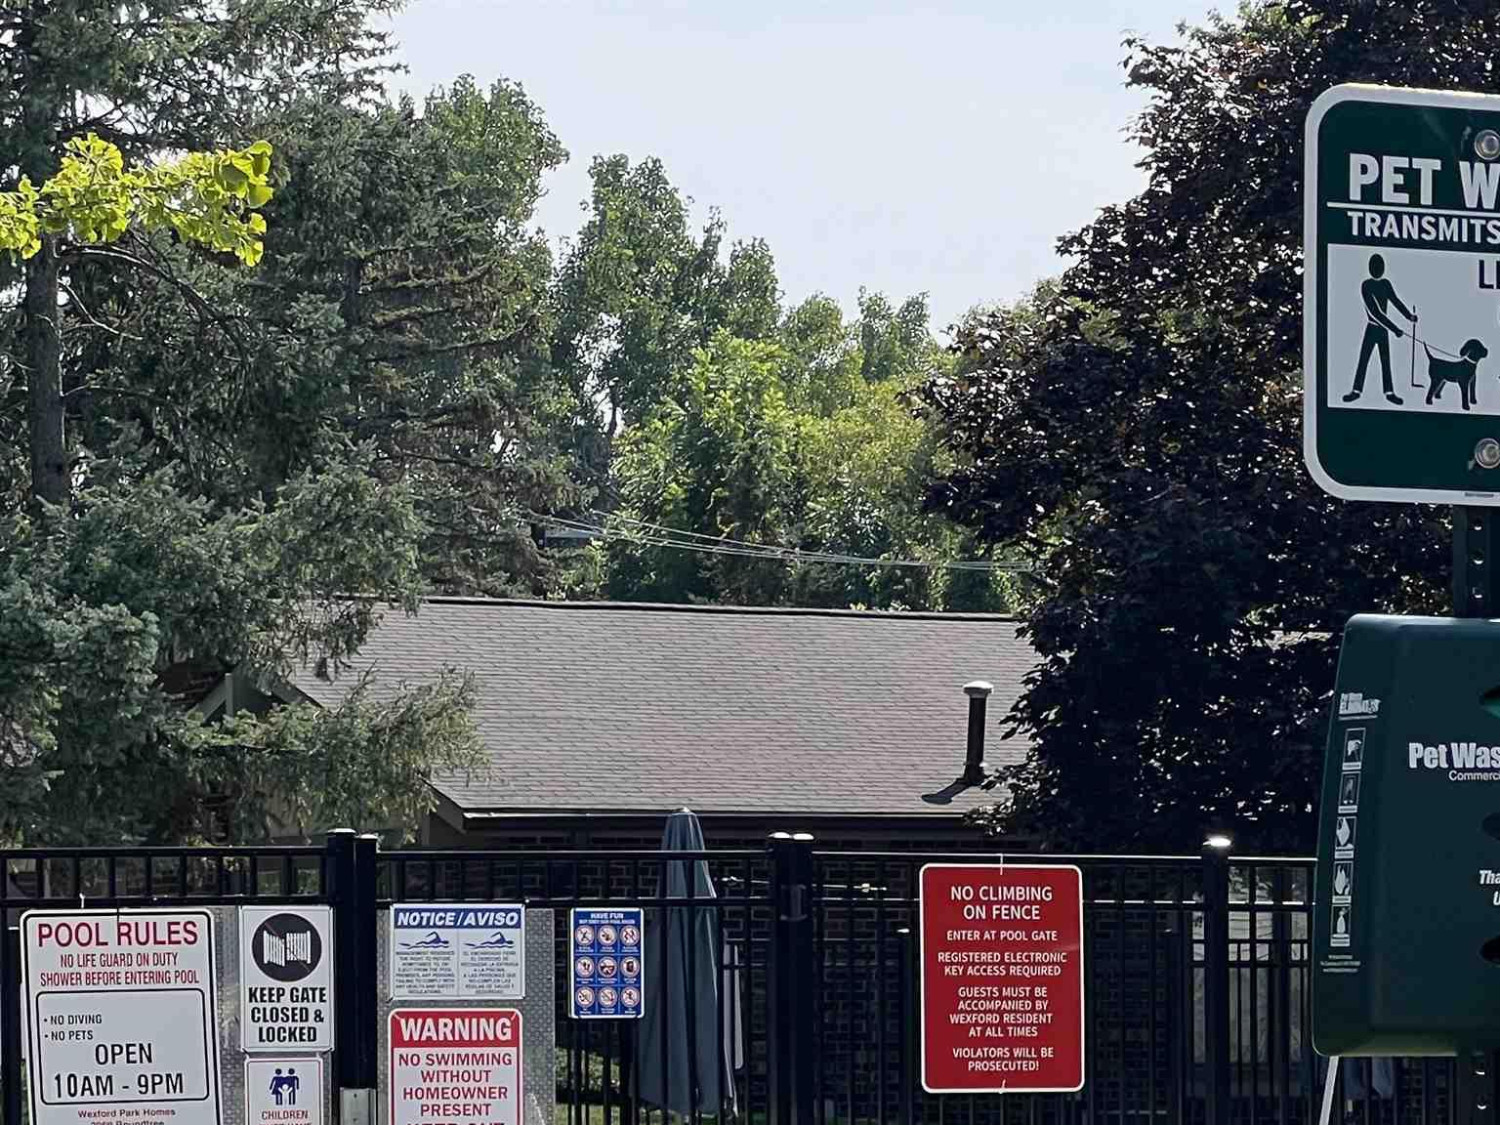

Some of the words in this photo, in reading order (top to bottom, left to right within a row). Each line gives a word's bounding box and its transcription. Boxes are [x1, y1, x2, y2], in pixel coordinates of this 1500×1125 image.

[1349, 153, 1441, 205] PET
[1408, 742, 1449, 769] Pet
[951, 886, 973, 901] NO
[979, 886, 1053, 901] CLIMBING
[963, 905, 987, 920] ON
[992, 905, 1041, 920] FENCE
[38, 922, 108, 947] POOL
[117, 921, 198, 946] RULES
[947, 931, 980, 941] ENTER
[983, 931, 996, 941] AT
[1000, 931, 1028, 941] POOL
[1031, 931, 1058, 941] GATE
[60, 954, 74, 967] NO
[77, 953, 97, 967] LIFE
[99, 953, 133, 967] GUARD
[136, 953, 150, 966] ON
[152, 952, 178, 966] DUTY
[938, 952, 1001, 963] REGISTERED
[1004, 952, 1067, 963] ELECTRONIC
[40, 972, 82, 986] SHOWER
[85, 971, 121, 985] BEFORE
[124, 970, 171, 985] ENTERING
[174, 970, 200, 984] POOL
[944, 966, 964, 976] KEY
[967, 966, 1006, 976] ACCESS
[1009, 966, 1061, 977] REQUIRED
[249, 987, 286, 1003] KEEP
[290, 987, 327, 1003] GATE
[958, 987, 999, 998] GUESTS
[1002, 987, 1031, 997] MUST
[1034, 987, 1047, 997] BE
[958, 1000, 1032, 1011] ACCOMPANIED
[1035, 1000, 1048, 1010] BY
[50, 1015, 64, 1025] NO
[68, 1014, 102, 1025] DIVING
[251, 1007, 309, 1023] CLOSED
[314, 1009, 325, 1023] &
[950, 1013, 1000, 1024] WEXFORD
[1003, 1013, 1052, 1024] RESIDENT
[51, 1031, 65, 1041] NO
[68, 1030, 93, 1040] PETS
[258, 1026, 317, 1043] LOCKED
[401, 1017, 512, 1042] WARNING
[968, 1026, 982, 1037] AT
[985, 1026, 1004, 1037] ALL
[1007, 1026, 1038, 1037] TIMES
[95, 1043, 153, 1065] OPEN
[398, 1054, 420, 1066] NO
[425, 1053, 512, 1066] SWIMMING
[953, 1048, 1010, 1058] VIOLATORS
[1013, 1048, 1037, 1058] WILL
[1040, 1048, 1054, 1058] BE
[968, 1061, 1039, 1071] PROSECUTED!
[421, 1070, 492, 1083] WITHOUT
[54, 1073, 113, 1098] 10AM
[137, 1073, 184, 1094] 9PM
[403, 1086, 508, 1100] HOMEOWNER
[77, 1110, 117, 1118] Wexford
[119, 1109, 140, 1117] Park
[143, 1109, 176, 1117] Homes
[261, 1110, 308, 1120] CHILDREN
[420, 1103, 491, 1117] PRESENT
